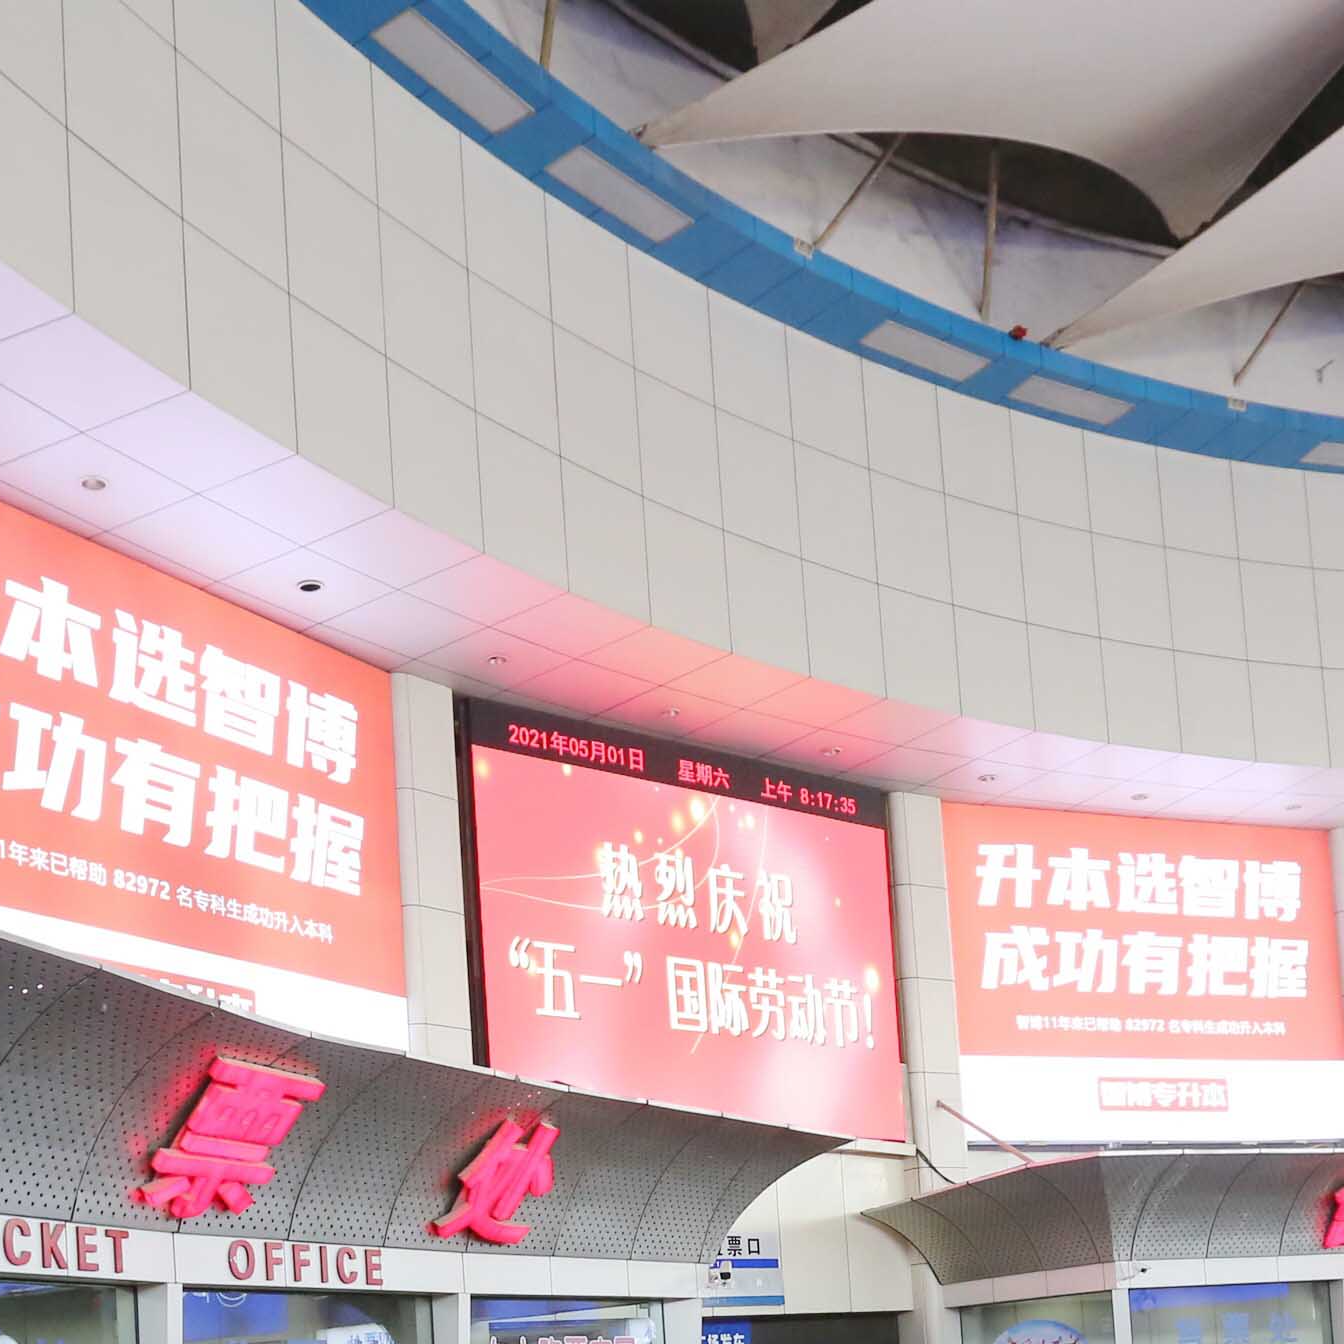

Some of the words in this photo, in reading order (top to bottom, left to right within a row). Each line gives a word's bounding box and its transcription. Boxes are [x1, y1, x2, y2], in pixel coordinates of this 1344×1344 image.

[508, 724, 645, 772] 2021年05月01日
[677, 760, 731, 790] 星期六
[760, 778, 793, 803] 上午
[799, 787, 856, 815] 8:17:35
[113, 869, 171, 901] 82972
[175, 885, 333, 944] 名专科生成功升入本科
[599, 841, 798, 945] 热烈庆祝
[975, 842, 1303, 922] 升本选智博
[981, 925, 1308, 999] 成功有把握
[228, 1239, 384, 1286] OFFICE
[717, 1236, 760, 1257] 票口
